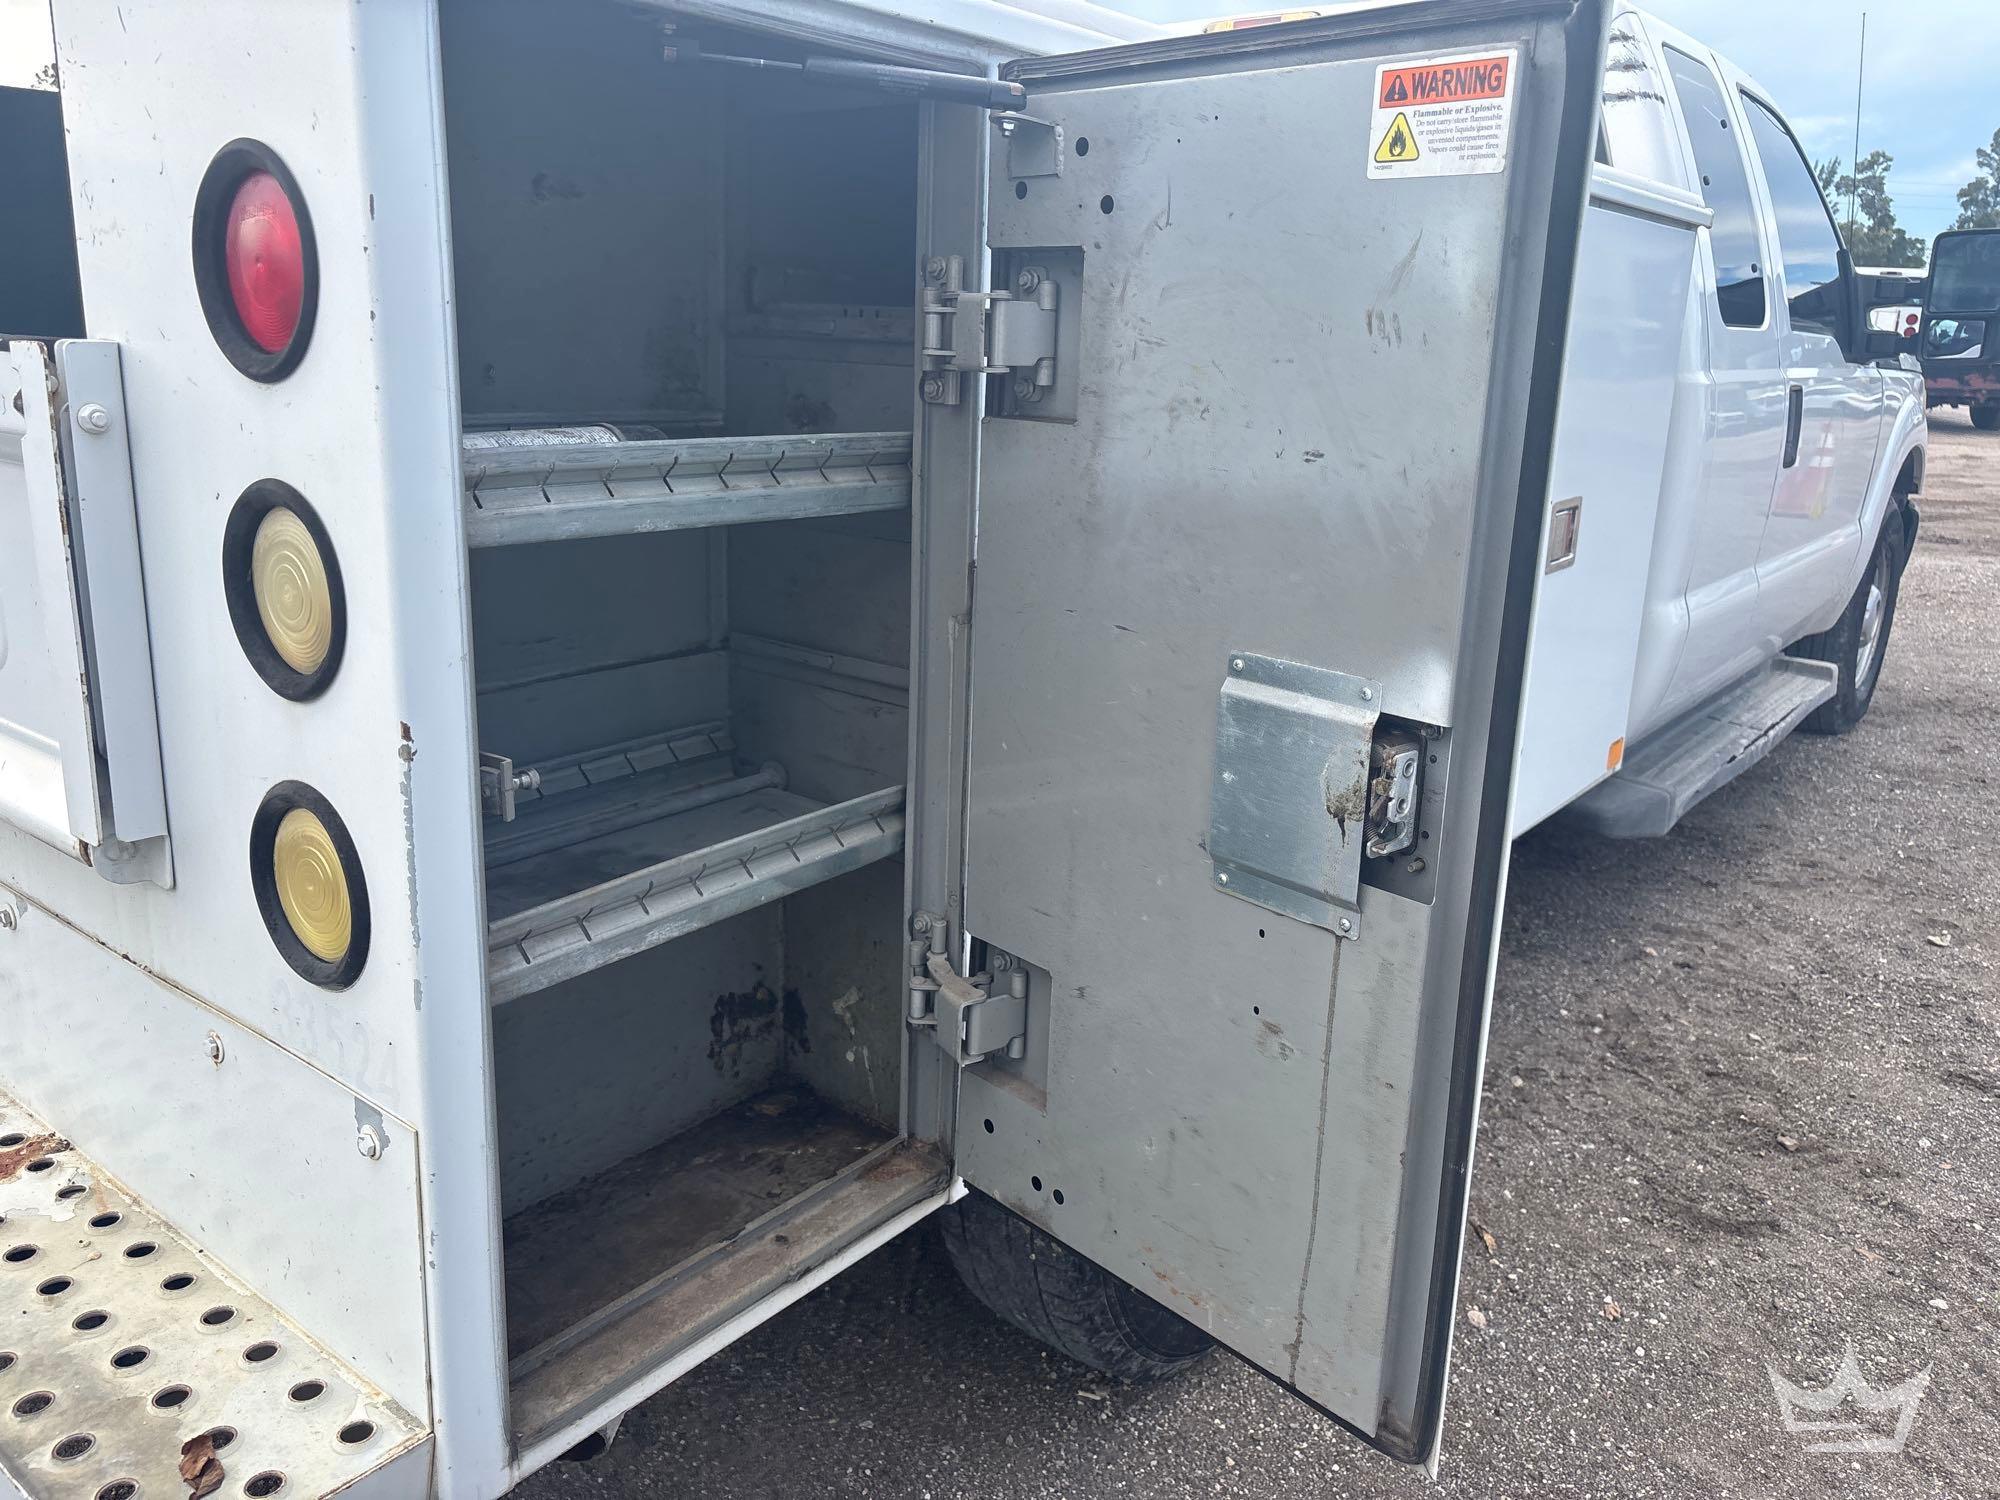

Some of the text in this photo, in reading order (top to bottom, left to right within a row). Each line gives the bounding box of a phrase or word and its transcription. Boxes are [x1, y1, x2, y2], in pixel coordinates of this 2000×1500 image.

[1412, 64, 1503, 99] WARNING
[1413, 107, 1453, 118] Flammable
[1465, 103, 1503, 114] Explosive.
[1470, 113, 1503, 121] flammable
[1426, 126, 1453, 136] explosive
[1428, 136, 1455, 144] unvented
[1428, 146, 1448, 154] Vapors
[1466, 152, 1497, 161] explosion.
